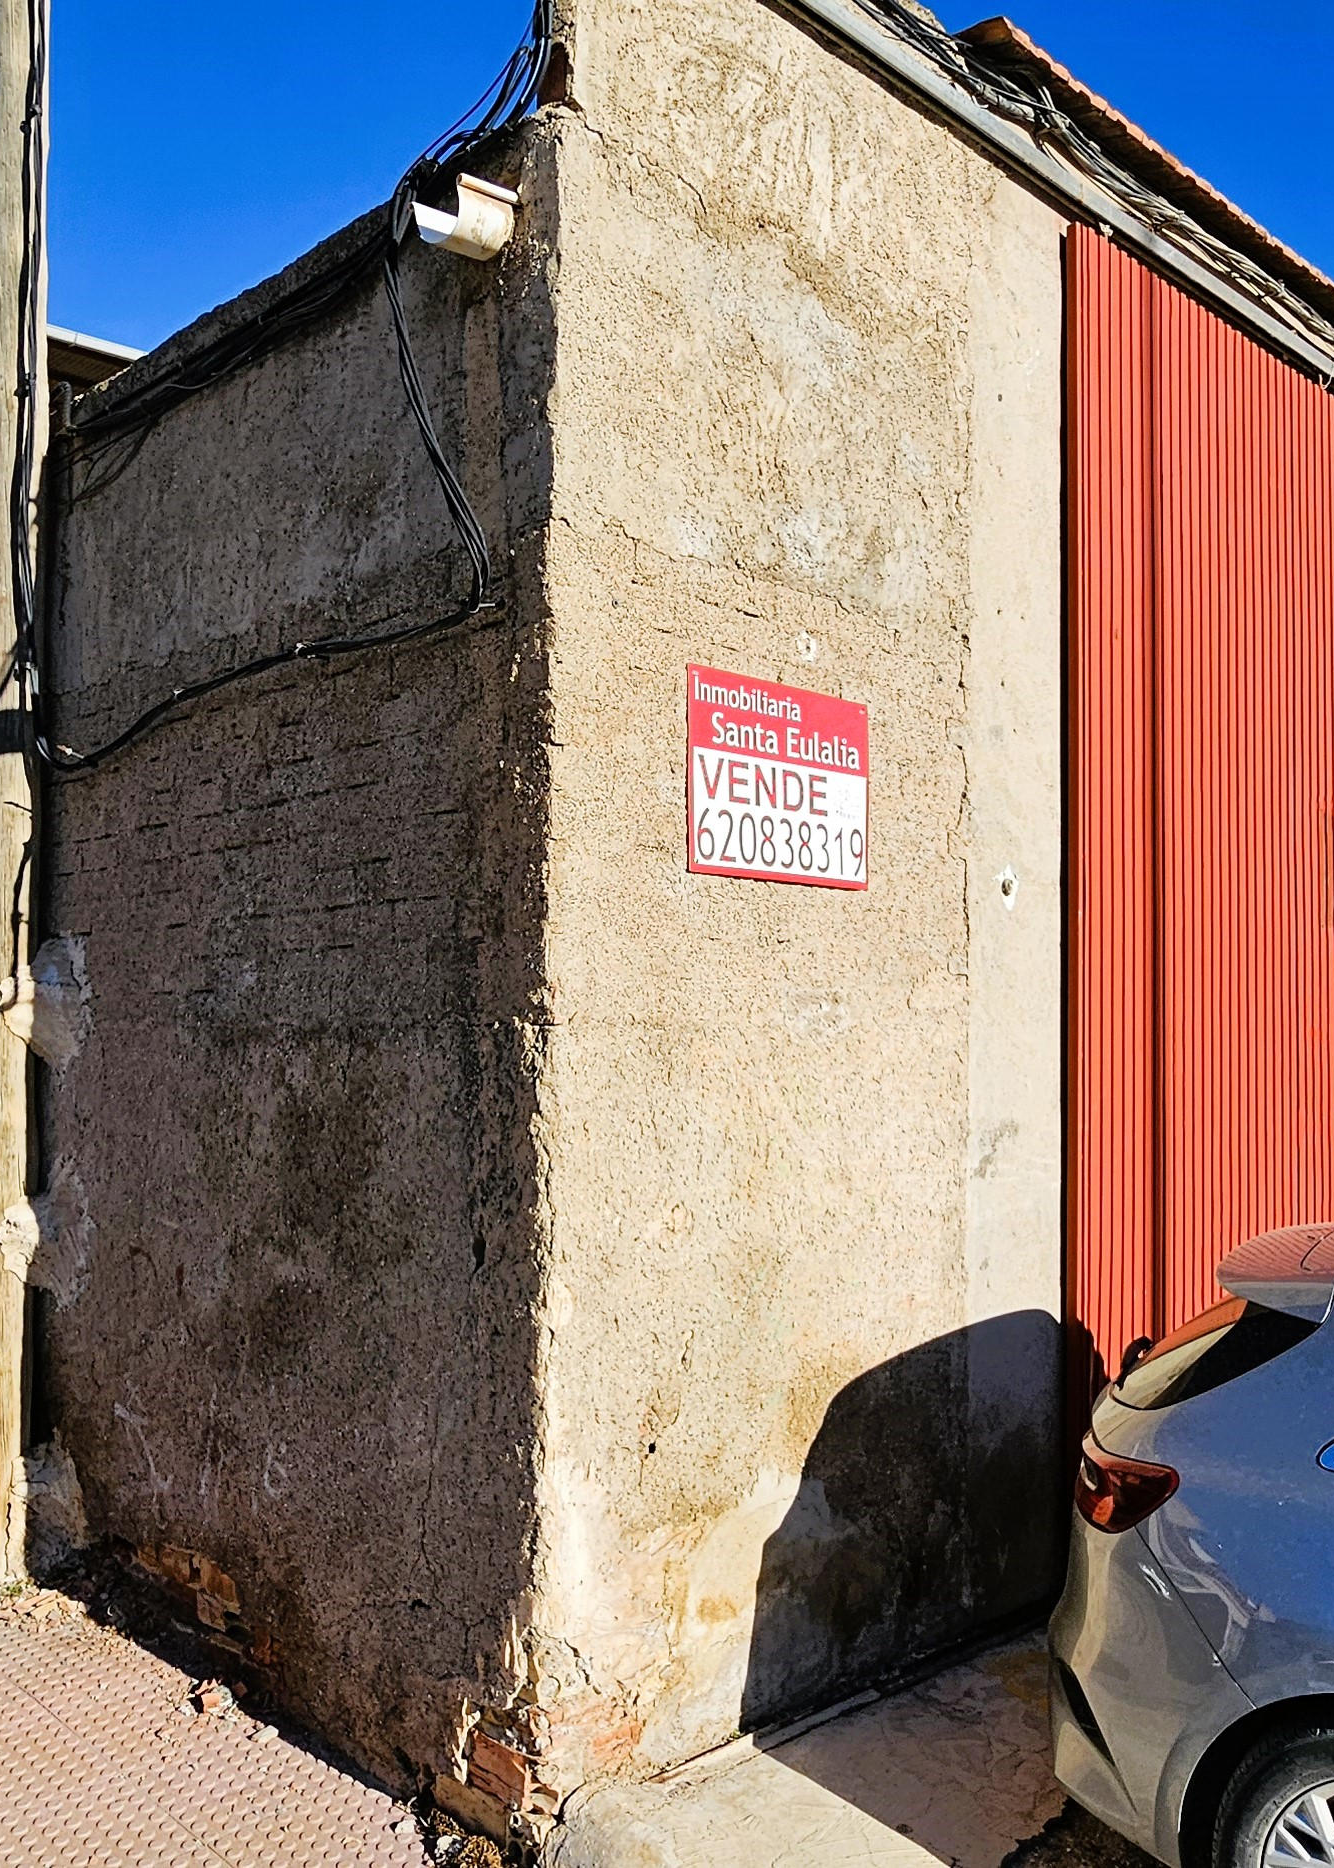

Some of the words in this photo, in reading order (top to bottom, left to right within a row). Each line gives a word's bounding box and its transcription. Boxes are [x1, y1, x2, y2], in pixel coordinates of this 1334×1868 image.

[694, 674, 802, 722] Inmobiliaria
[711, 711, 779, 755] Santa
[786, 726, 860, 770] Eulalia
[698, 754, 828, 817] VENDE
[697, 807, 863, 877] 620838319
